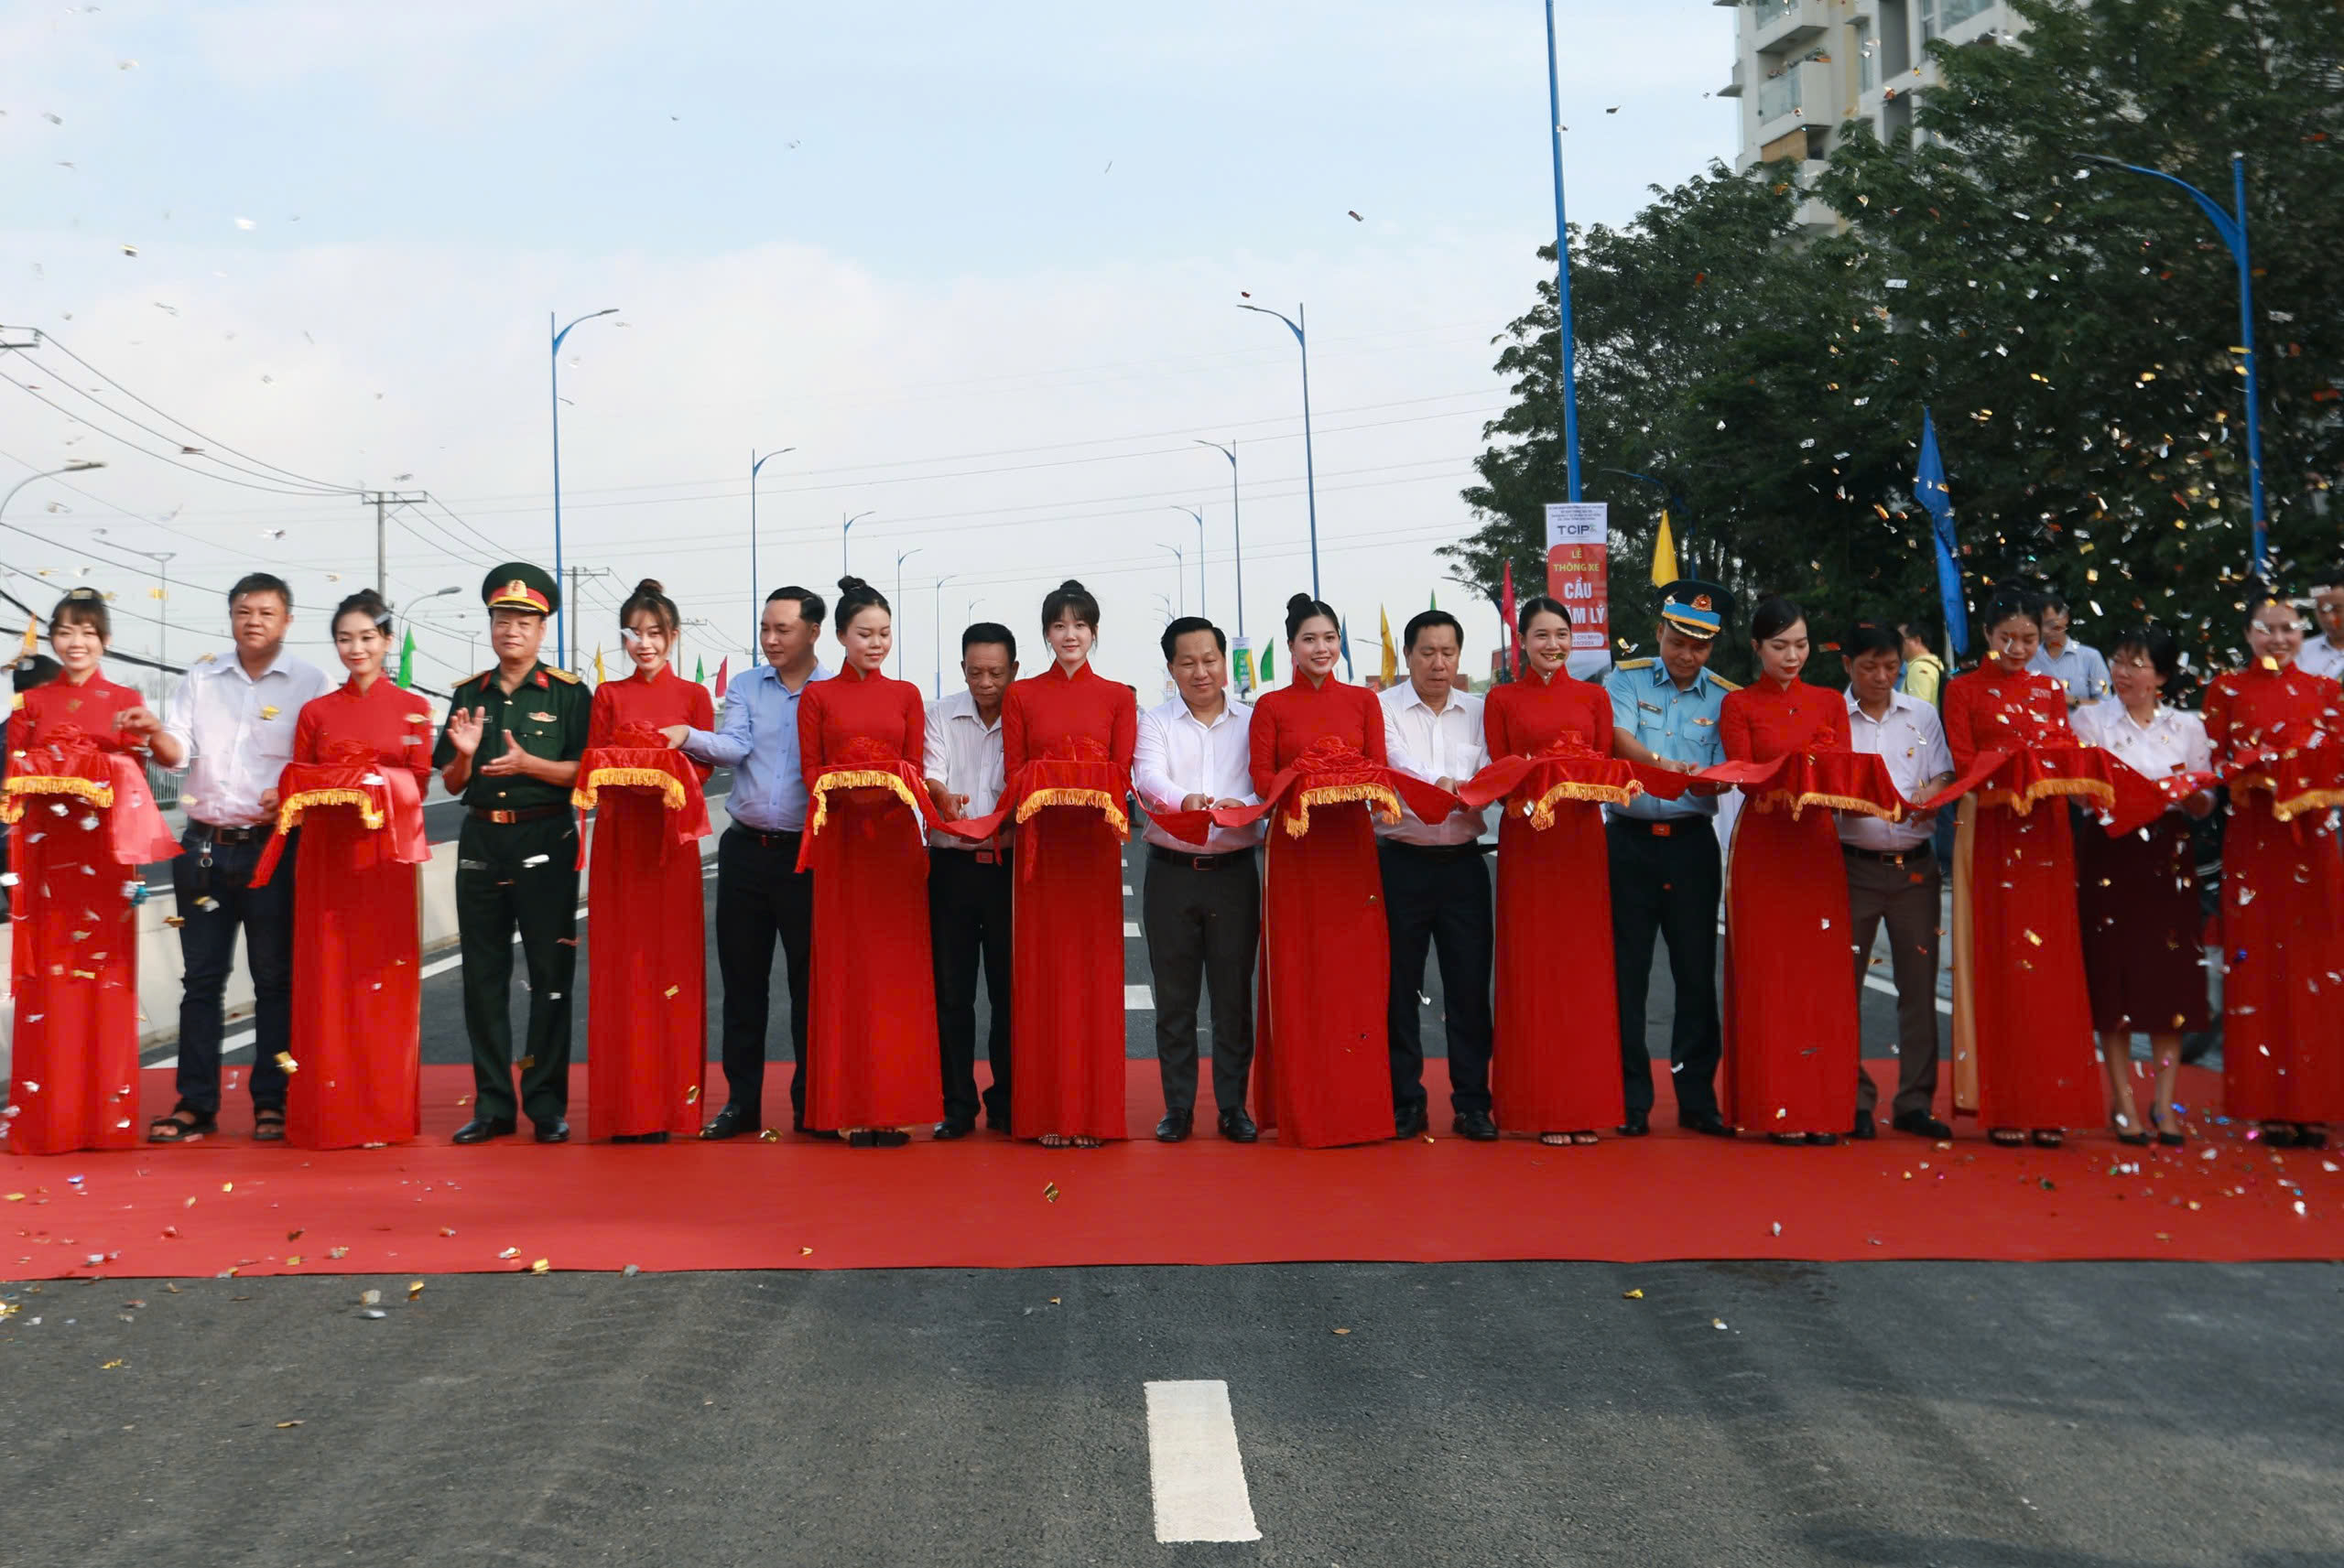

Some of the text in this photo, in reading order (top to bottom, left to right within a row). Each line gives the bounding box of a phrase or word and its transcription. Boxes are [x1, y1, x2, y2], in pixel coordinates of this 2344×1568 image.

[1557, 524, 1590, 535] TCIP
[1553, 562, 1600, 572] THÔNG XE
[1565, 604, 1605, 624] ĂM LÝ
